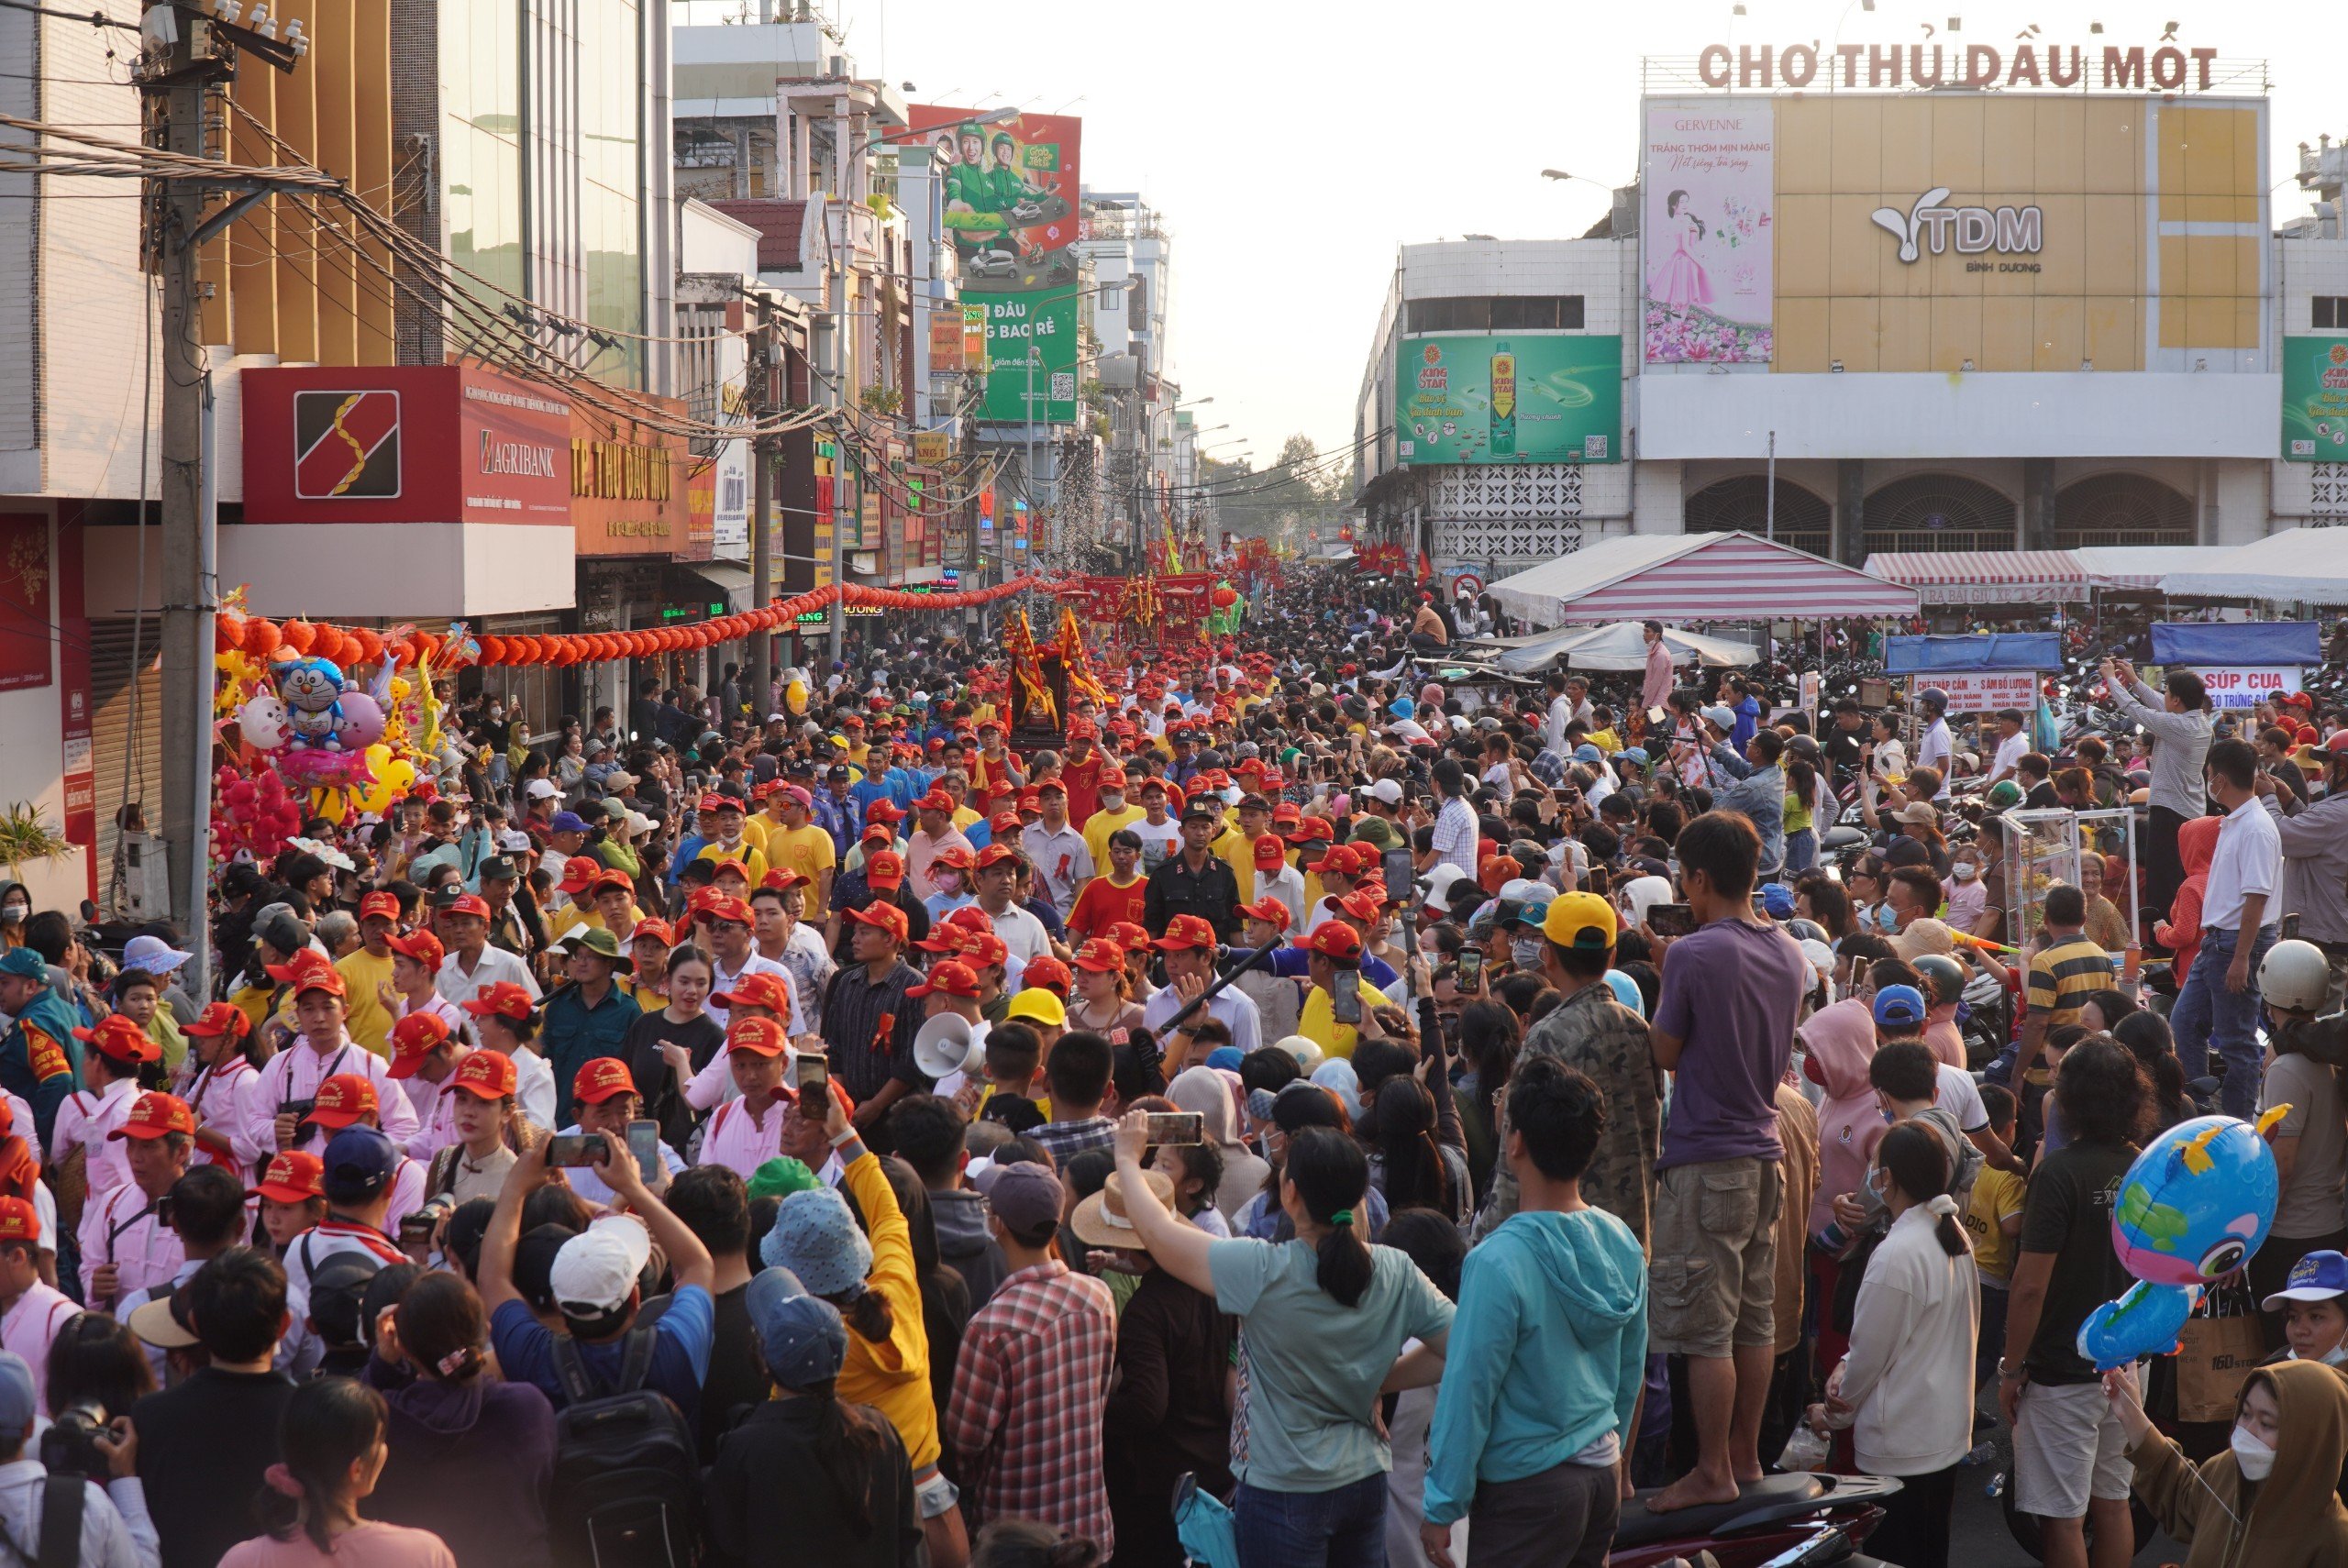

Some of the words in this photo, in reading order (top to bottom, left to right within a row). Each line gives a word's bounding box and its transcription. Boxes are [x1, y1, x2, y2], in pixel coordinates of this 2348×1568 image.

[1699, 39, 1821, 101] CHỢ
[1836, 24, 1943, 89] THỦ
[1965, 23, 2082, 89] DẦU
[2102, 31, 2218, 101] MỘT
[1675, 119, 1744, 130] GERVENNE
[1740, 141, 1771, 151] MÀNG
[1917, 206, 2043, 255] TDM
[1966, 260, 1994, 272] BÌNH
[1999, 262, 2042, 272] DƯƠNG
[994, 301, 1026, 318] ĐÂU
[1036, 316, 1056, 337] RẺ
[994, 359, 1011, 367] giảm
[1423, 367, 1447, 377] KING
[2328, 368, 2348, 377] KIN
[1419, 375, 1447, 391] STAR
[493, 441, 556, 478] AGRIBANK
[570, 437, 592, 497] TP.
[944, 569, 958, 577] VÀN
[1929, 589, 1944, 602] RA
[1995, 589, 2011, 602] XE
[2205, 670, 2241, 689] SÚP
[2247, 673, 2283, 689] CUA
[2223, 690, 2254, 708] TRỨNG
